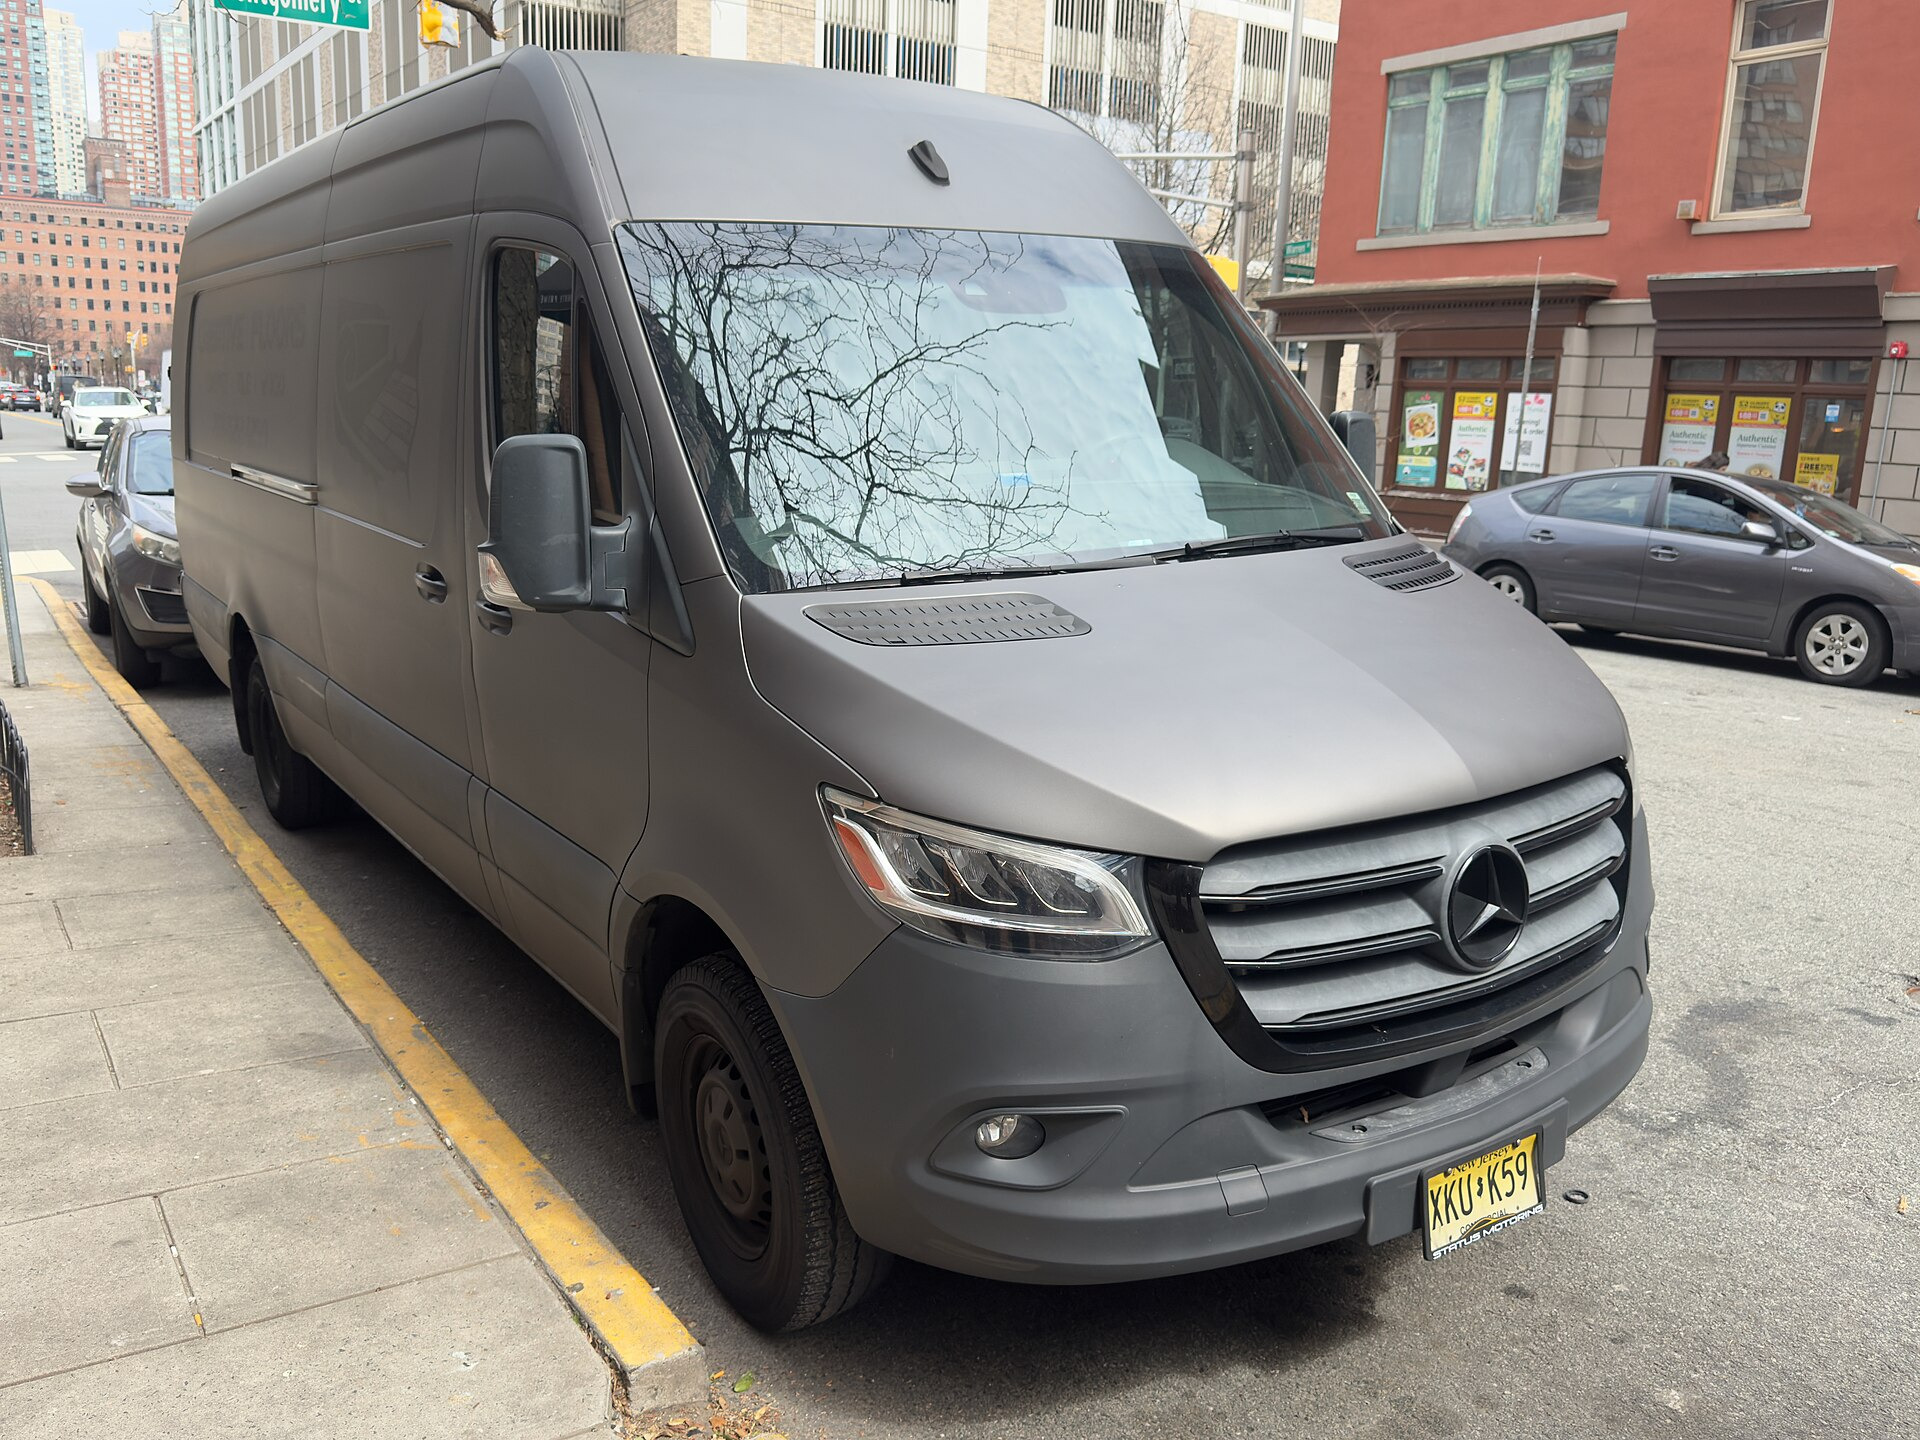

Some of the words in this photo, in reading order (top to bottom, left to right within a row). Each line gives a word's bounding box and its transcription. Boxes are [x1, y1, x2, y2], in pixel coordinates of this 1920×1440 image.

[1669, 430, 1708, 440] Authentic
[1737, 433, 1778, 444] Authentic
[1477, 1145, 1510, 1169] Jersey
[1429, 1173, 1474, 1231] XKU
[1487, 1151, 1528, 1205] K59
[1432, 1231, 1481, 1260] STATUS
[1482, 1203, 1544, 1238] MOTORING
